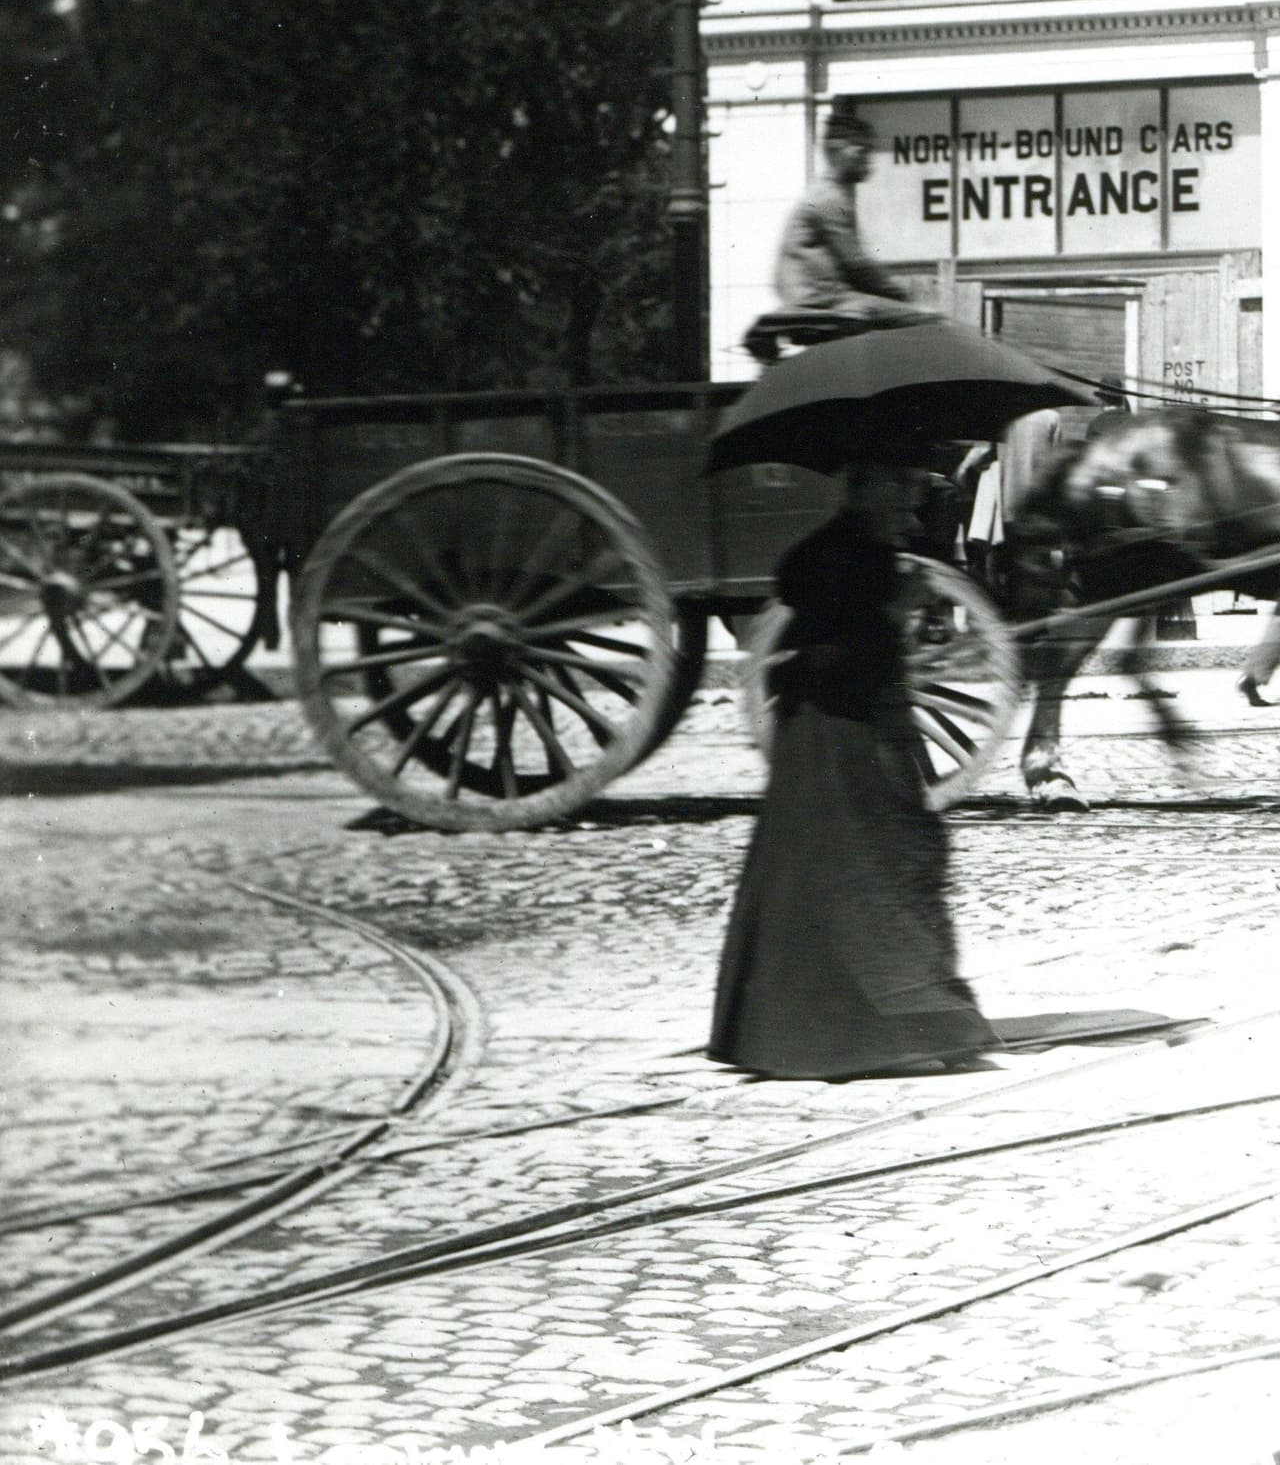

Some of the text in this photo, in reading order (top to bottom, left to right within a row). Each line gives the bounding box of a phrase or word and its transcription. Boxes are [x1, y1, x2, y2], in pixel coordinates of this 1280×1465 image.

[893, 121, 1234, 165] NORTH-BOUND CARS
[922, 168, 1200, 221] ENTRANCE
[1163, 360, 1206, 377] POST
[1174, 379, 1195, 395] NO
